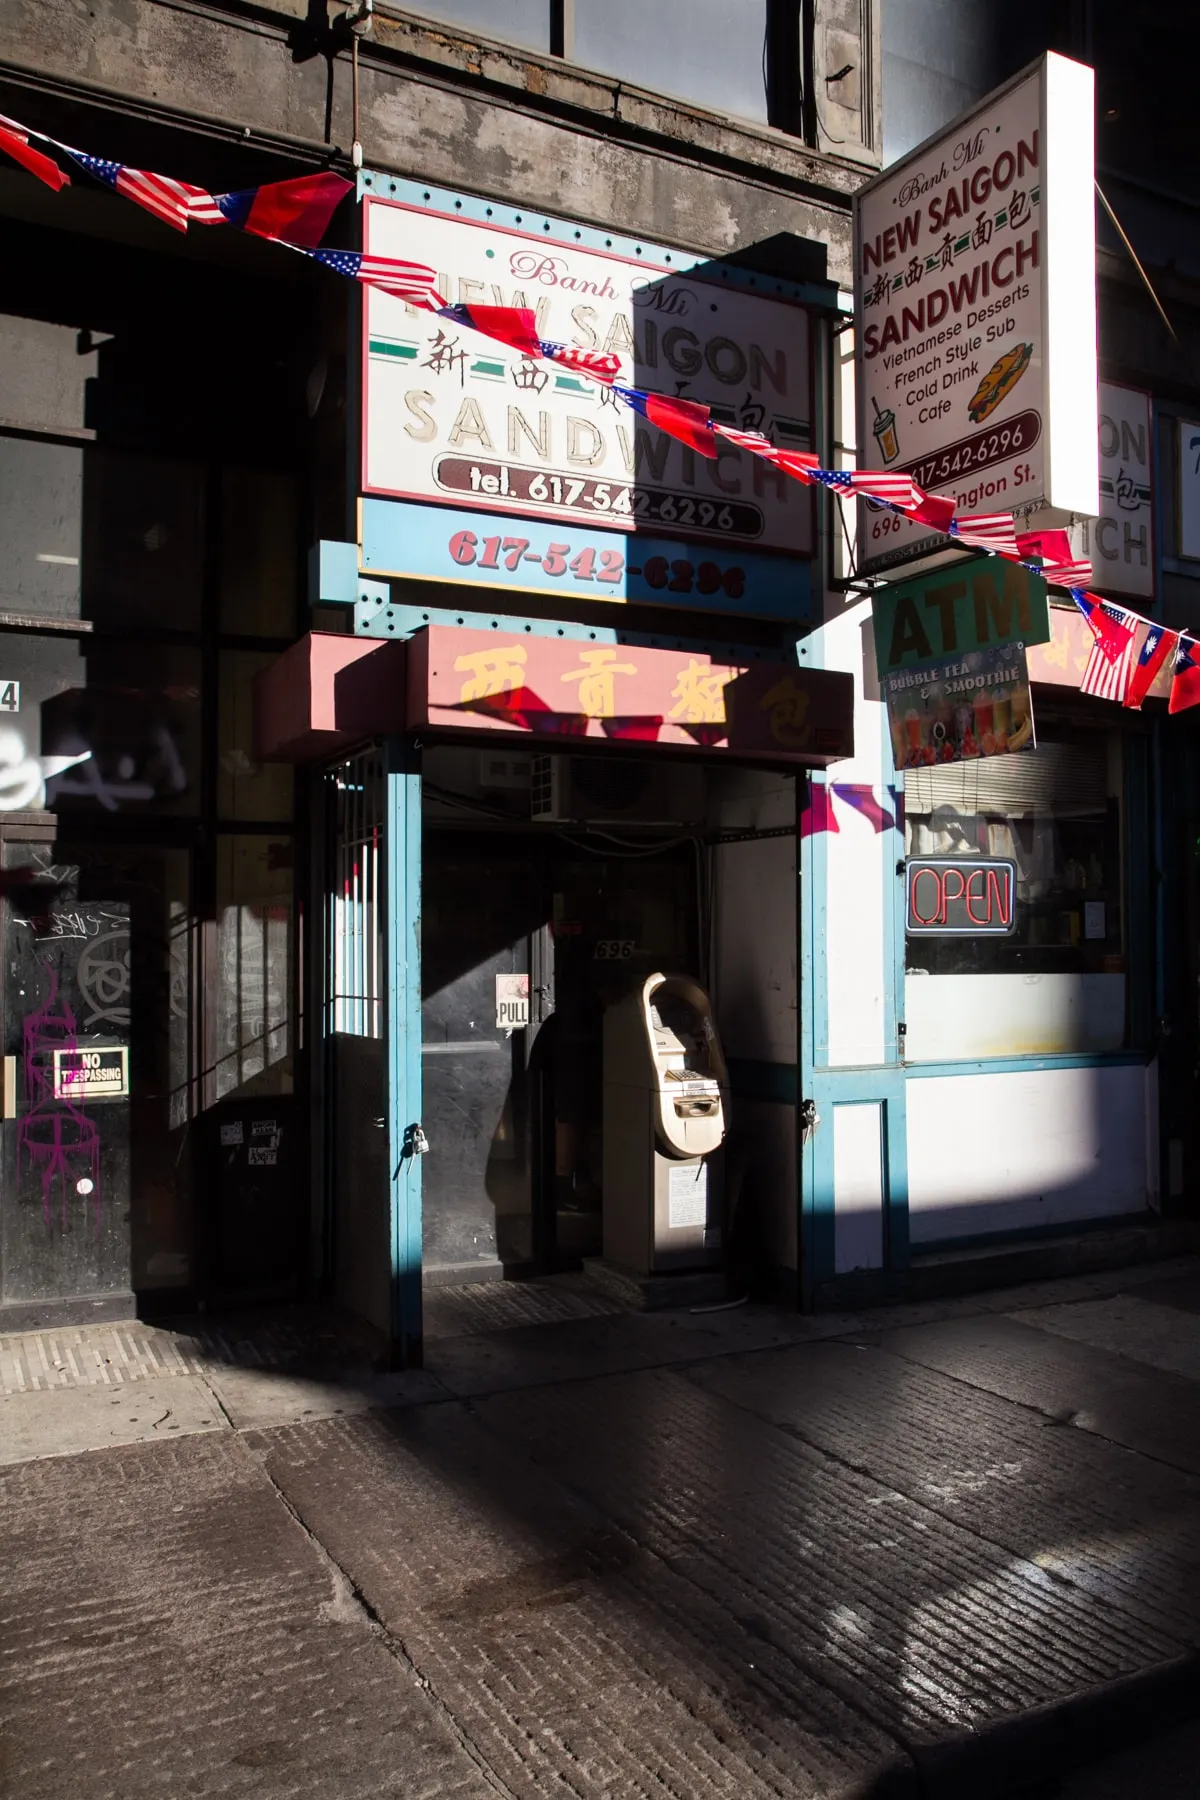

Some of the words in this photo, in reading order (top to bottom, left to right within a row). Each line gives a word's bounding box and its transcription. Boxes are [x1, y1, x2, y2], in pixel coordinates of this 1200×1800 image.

[900, 161, 950, 208] Banh
[953, 127, 990, 172] Mi
[863, 209, 922, 275] NEW
[928, 128, 1040, 234] SAIGON
[509, 250, 620, 300] Banh
[629, 276, 699, 317] Mi
[863, 230, 1040, 360] SANDWICH
[570, 303, 789, 397] SAIGON
[883, 322, 962, 371] Vietnamese
[966, 284, 1030, 329] Desserts
[895, 356, 941, 389] French
[946, 336, 981, 364] Style
[986, 317, 1016, 343] Sub
[905, 379, 938, 406] Cold
[942, 361, 979, 389] Drink
[918, 399, 952, 424] Cafe
[403, 389, 789, 504] SANDWICH
[469, 465, 517, 497] tel.
[528, 473, 735, 531] 617-542-6296
[872, 514, 901, 540] 696
[1014, 463, 1036, 487] St.
[448, 530, 746, 599] 617-542-6296
[888, 563, 1033, 666] ATM
[1, 682, 17, 711] 4
[889, 669, 940, 691] BUBBLE
[944, 663, 971, 678] TEA
[943, 666, 1021, 695] SMOOTHIE
[911, 867, 1010, 926] OPEN
[597, 941, 633, 959] 696
[500, 1002, 528, 1023] PULL
[61, 1067, 122, 1083] TRESPASSING
[81, 1053, 101, 1069] NO
